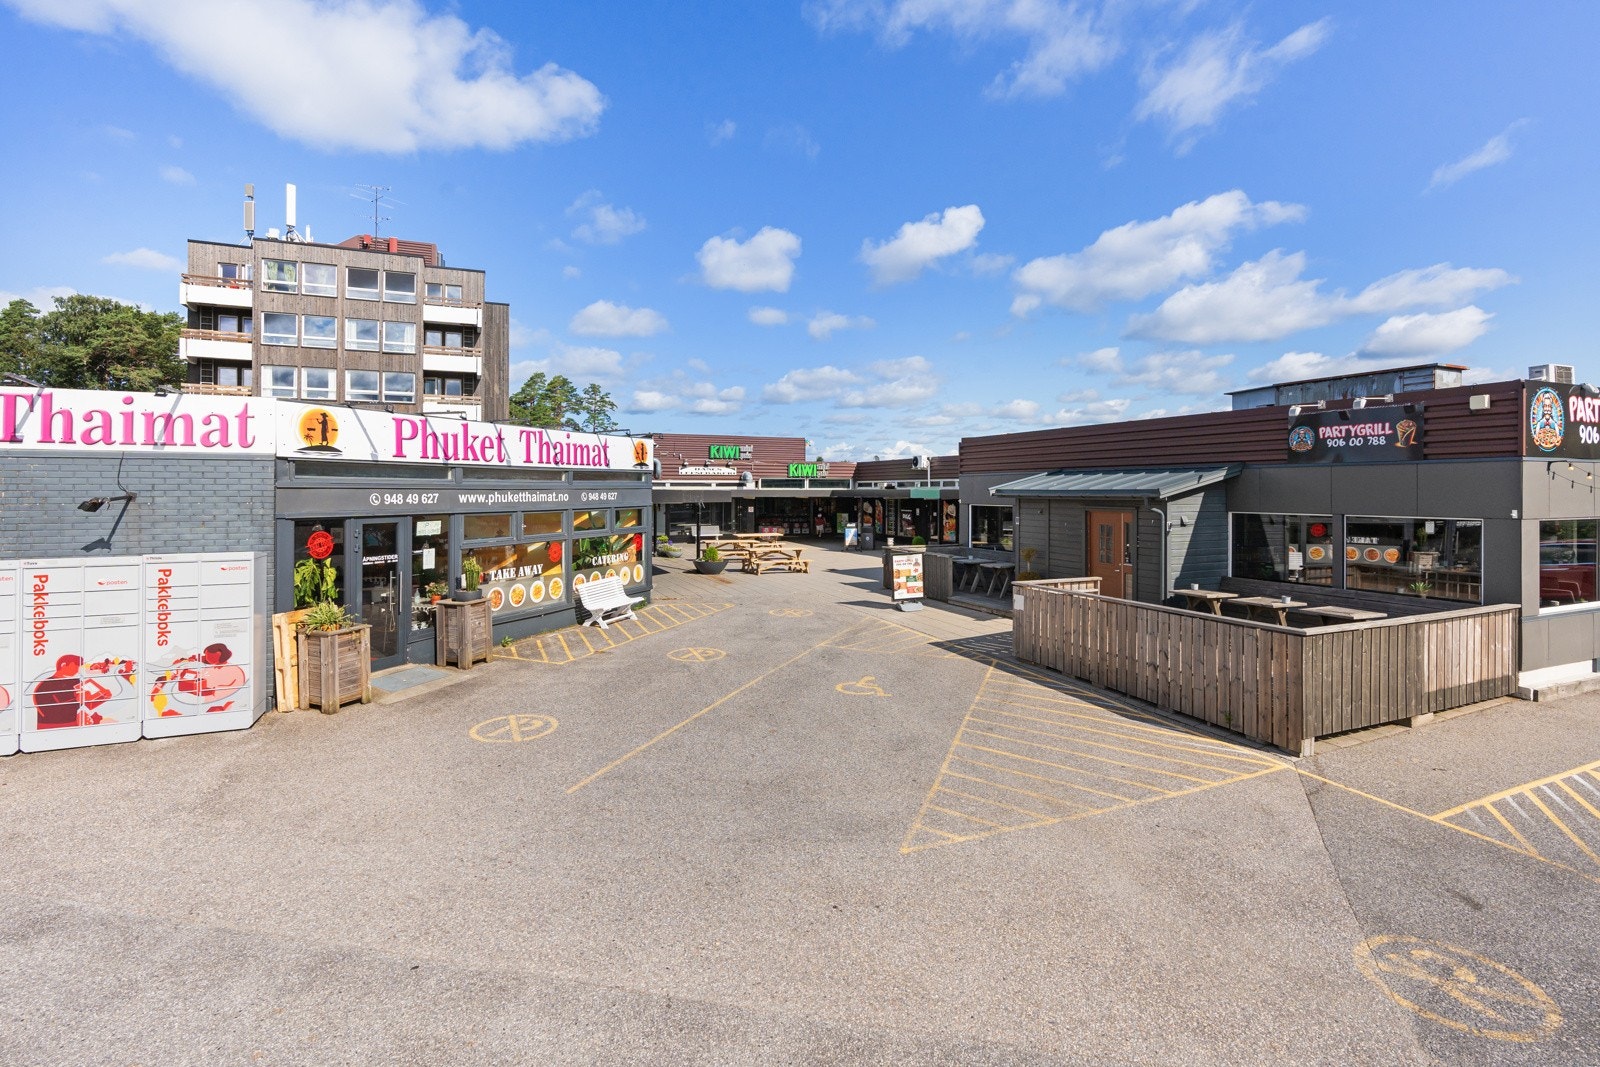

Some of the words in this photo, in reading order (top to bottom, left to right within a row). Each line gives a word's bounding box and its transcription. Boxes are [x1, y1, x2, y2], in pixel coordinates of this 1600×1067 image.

[0, 392, 255, 448] Thaimat
[1326, 437, 1345, 447] 906
[1349, 436, 1363, 446] 00
[1368, 435, 1386, 445] 788
[1579, 424, 1600, 444] 906
[392, 417, 505, 463] Phuket
[519, 429, 609, 467] Thaimat
[710, 445, 740, 459] KIWI
[789, 463, 818, 477] KIWI
[384, 493, 403, 504] 948
[406, 493, 419, 504] 49
[421, 493, 439, 504] 627
[458, 491, 569, 505] www.phuketthaimat.no
[588, 492, 599, 501] 948
[600, 492, 608, 501] 49
[608, 492, 618, 501] 627
[592, 552, 629, 566] CATERING
[490, 566, 517, 581] TAKE
[518, 563, 544, 578] AWAY
[157, 568, 172, 647] Pakkeboks
[33, 574, 49, 656] Pakkeboks
